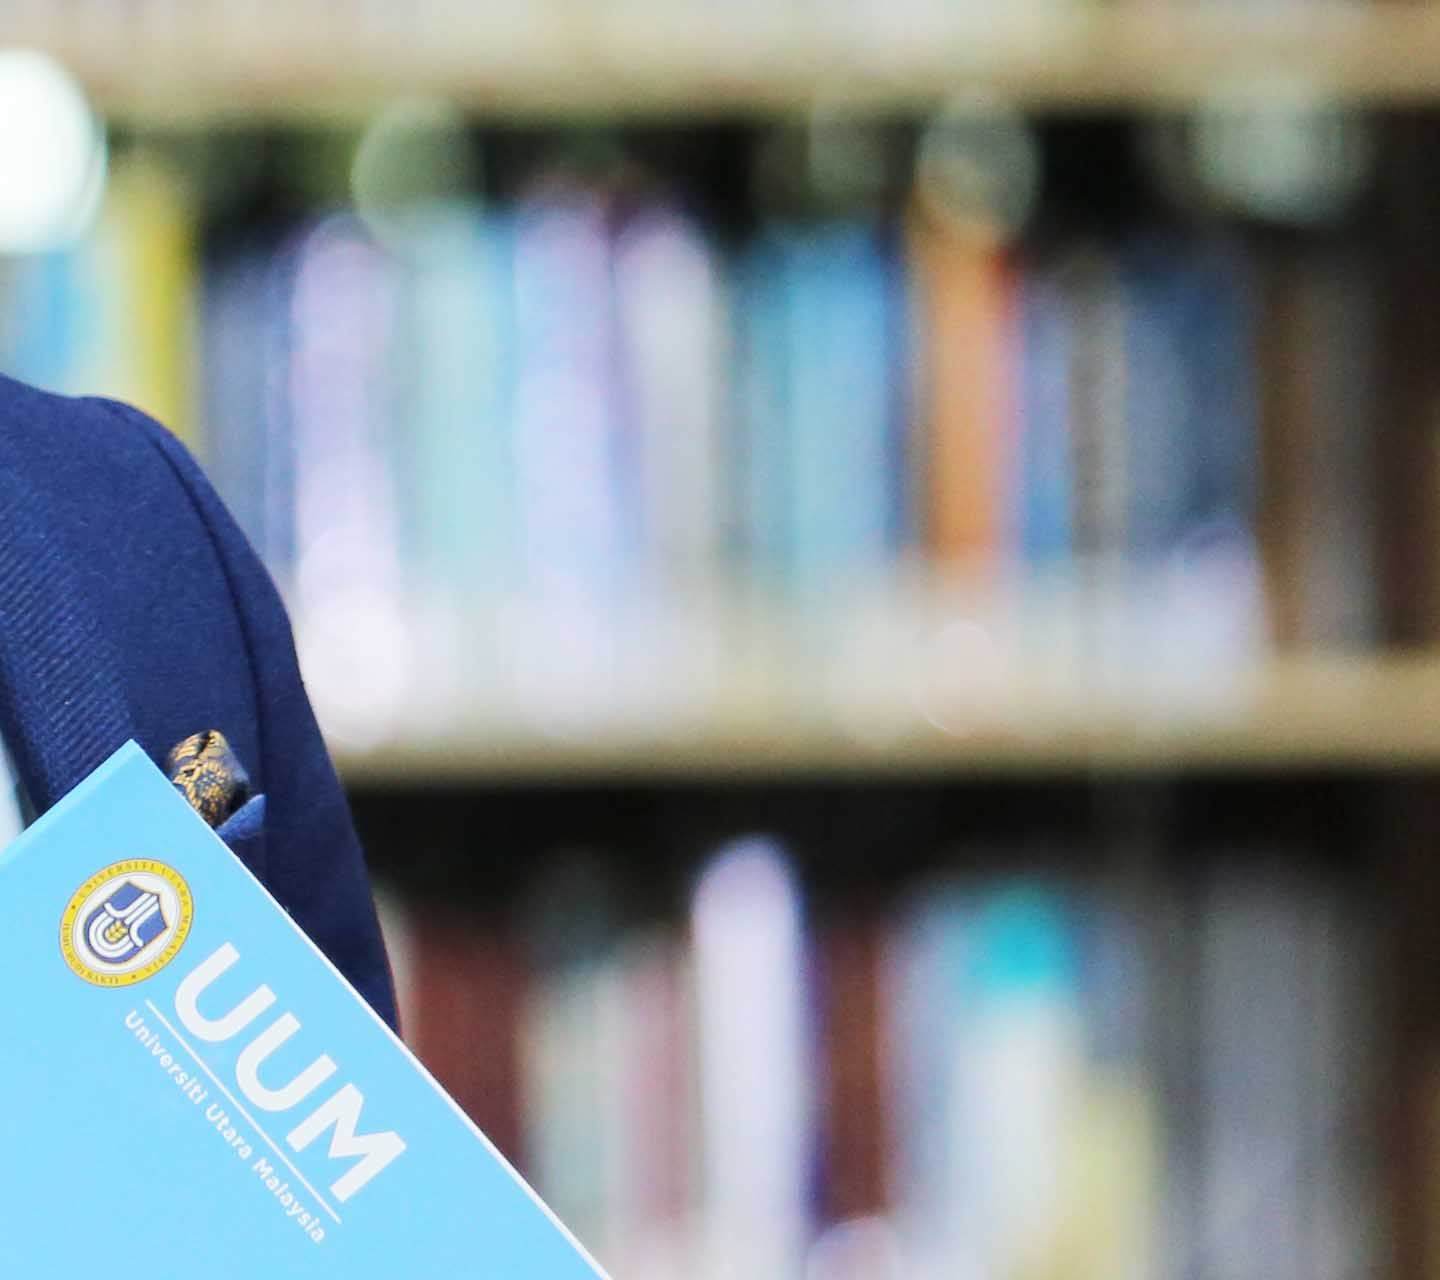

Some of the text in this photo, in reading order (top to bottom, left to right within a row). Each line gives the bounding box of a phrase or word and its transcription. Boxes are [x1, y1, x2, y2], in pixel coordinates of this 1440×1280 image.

[125, 1010, 326, 1243] Universiti Utara Malaysia
[174, 941, 408, 1204] UUM
